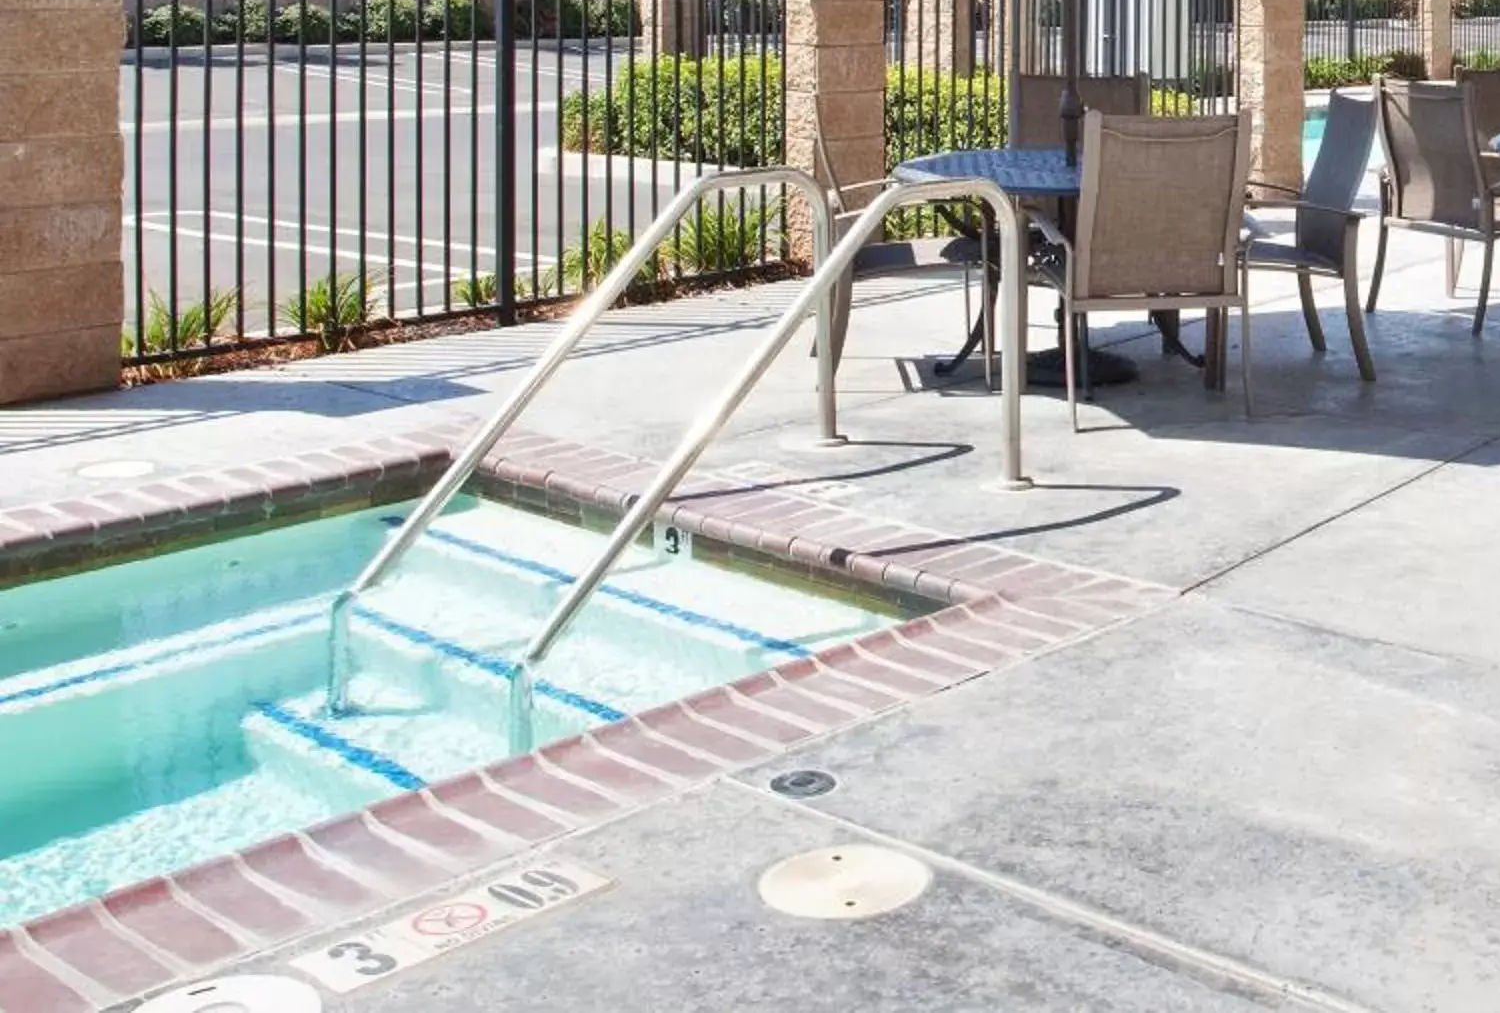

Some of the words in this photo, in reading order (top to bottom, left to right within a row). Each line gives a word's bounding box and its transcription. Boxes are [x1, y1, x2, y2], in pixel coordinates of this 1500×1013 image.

[665, 526, 679, 554] 3
[487, 869, 580, 909] 0.9
[328, 942, 397, 975] 3
